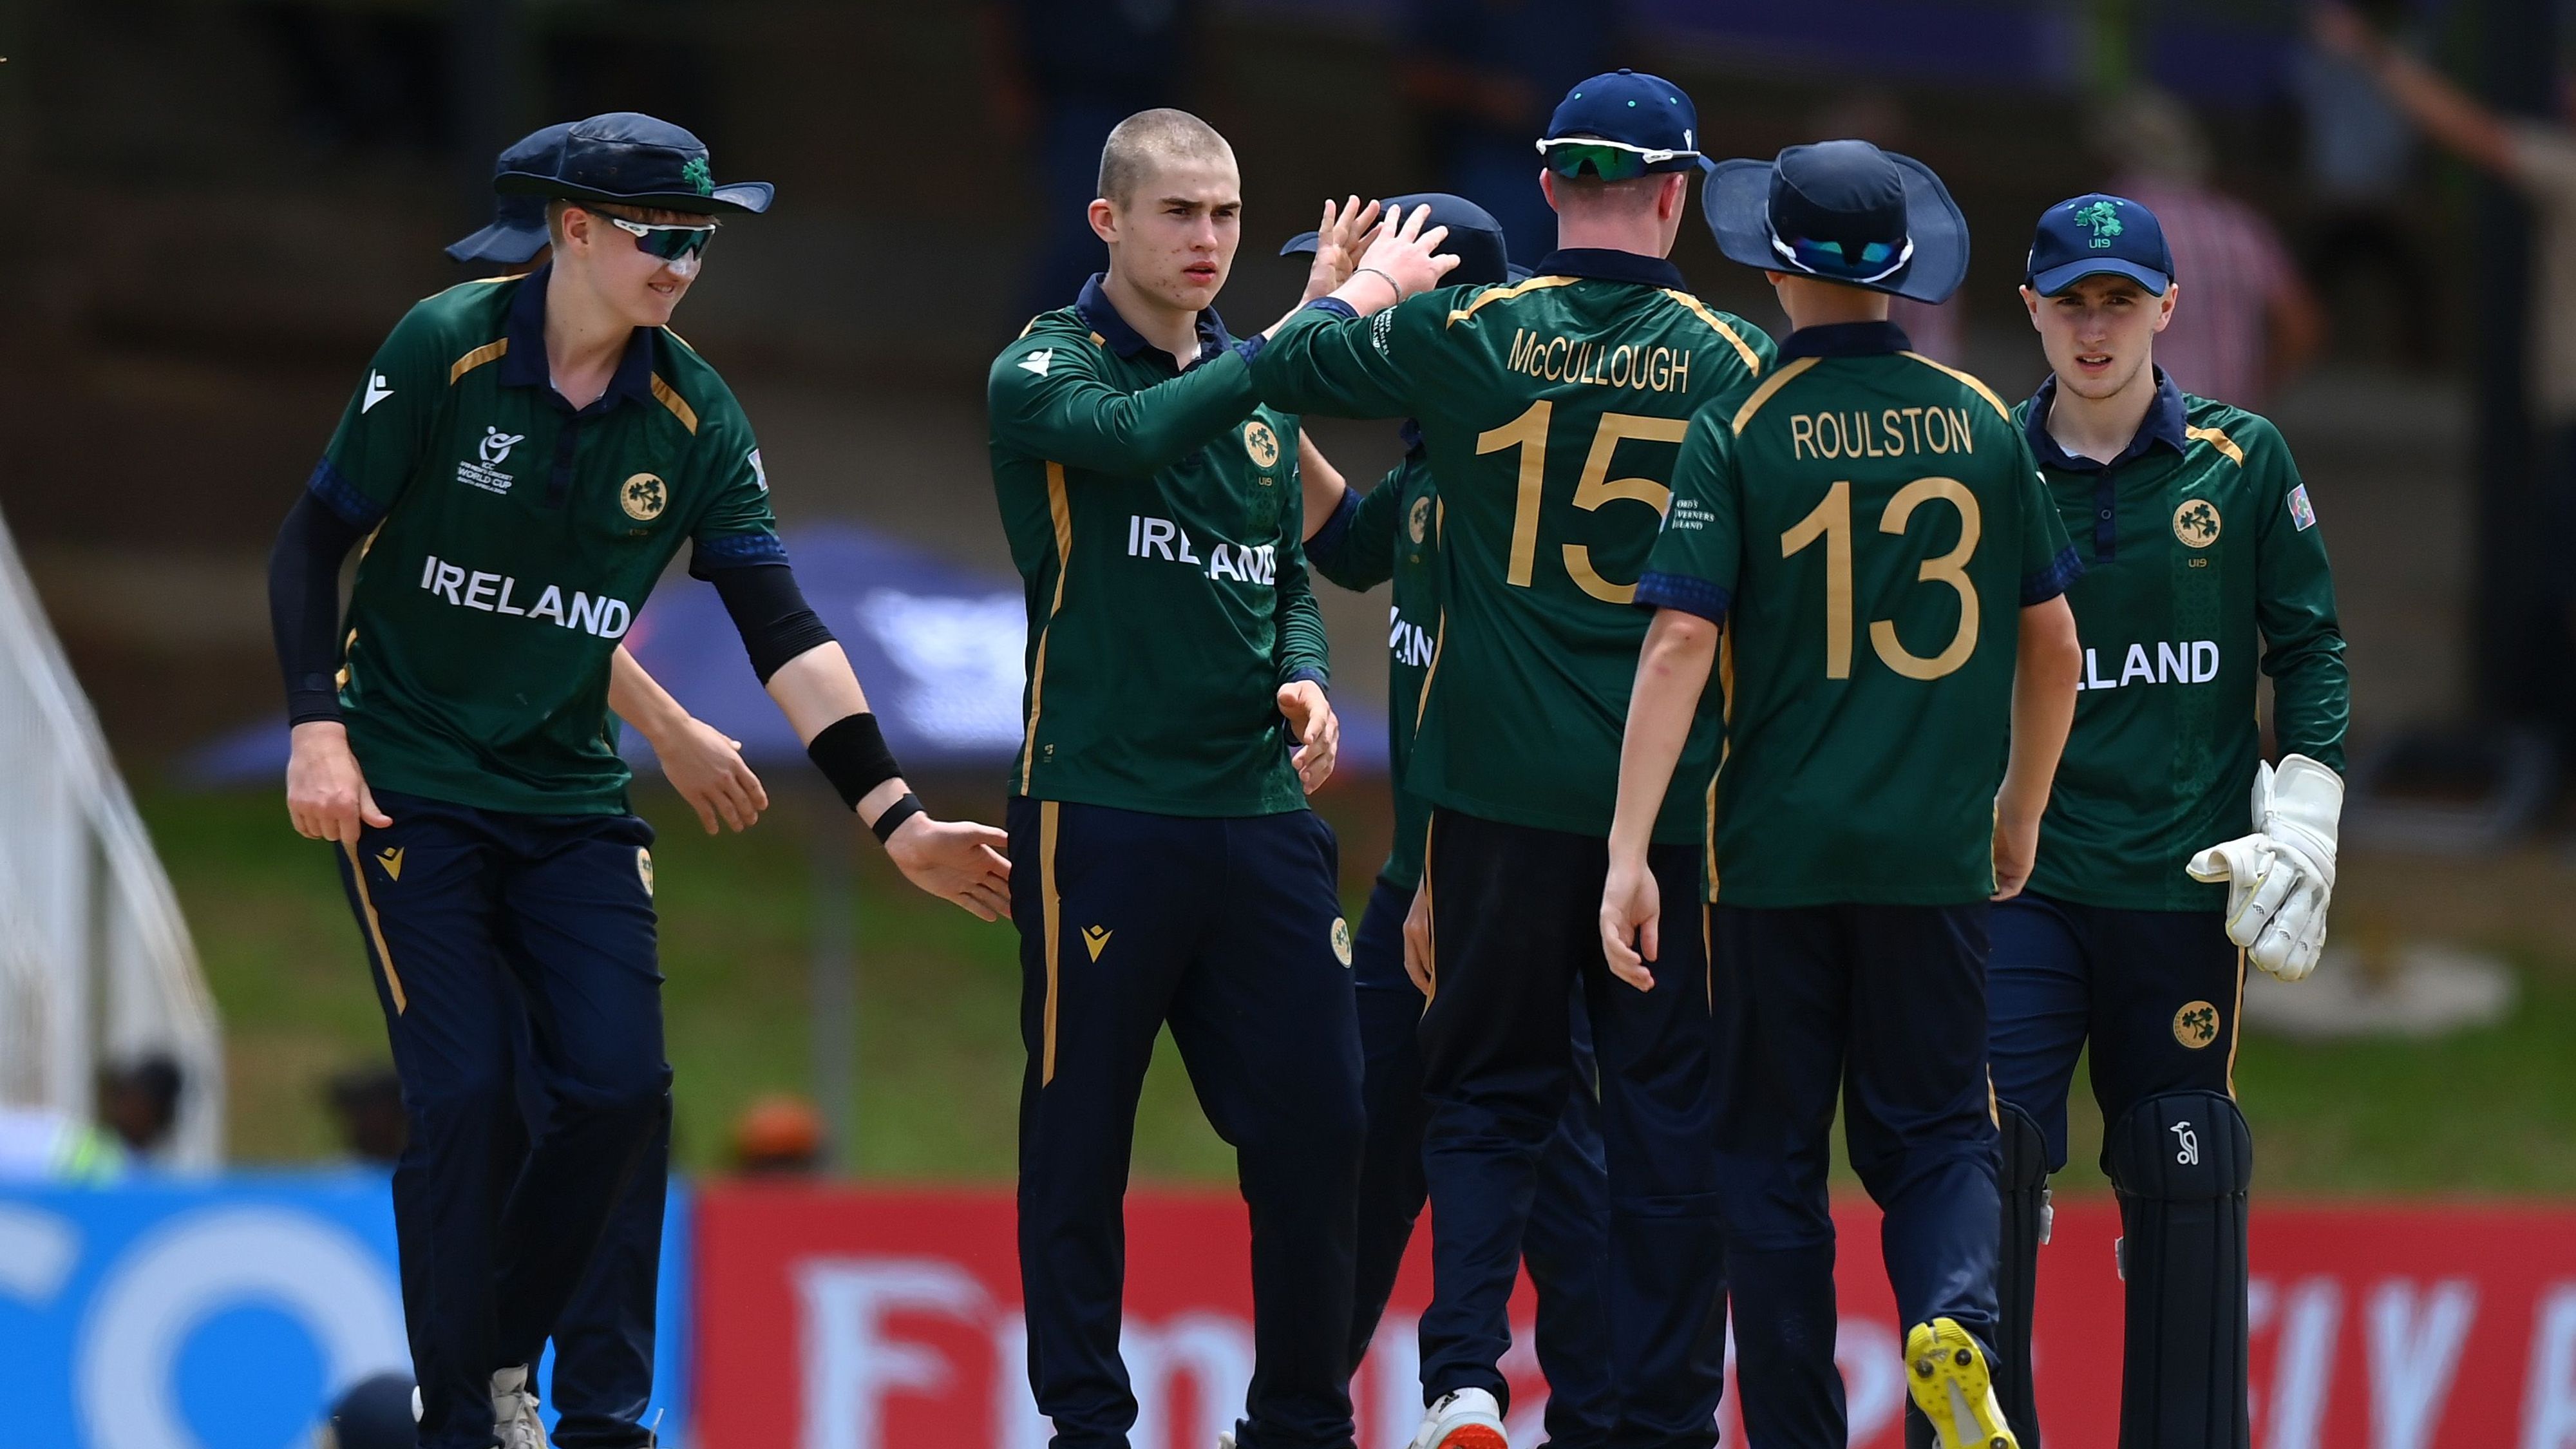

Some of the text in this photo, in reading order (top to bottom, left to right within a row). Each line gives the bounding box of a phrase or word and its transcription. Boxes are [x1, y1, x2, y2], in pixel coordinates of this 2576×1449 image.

[2088, 238, 2110, 249] U19
[1507, 328, 1690, 393] McCULLOUGH
[1790, 406, 1973, 460] ROULSTON
[458, 467, 512, 489] WORLD CUP
[1258, 477, 1273, 486] U19
[1475, 399, 1690, 604] 15
[1128, 515, 1276, 585] IRAND
[2188, 558, 2207, 568] U19
[421, 555, 631, 639] IRELAND
[1781, 477, 1981, 681] 13
[2076, 640, 2219, 690] LAND
